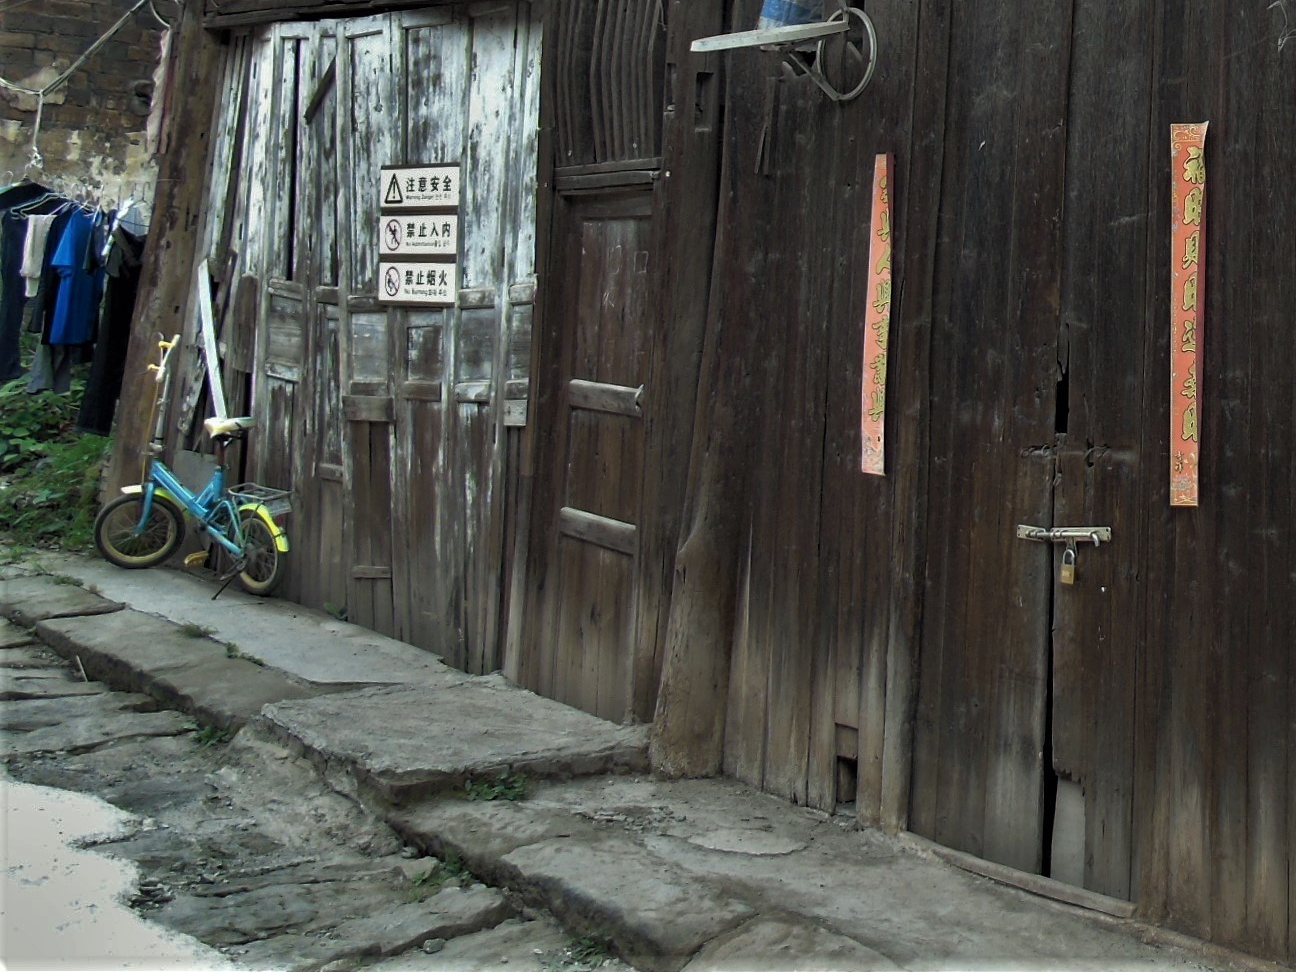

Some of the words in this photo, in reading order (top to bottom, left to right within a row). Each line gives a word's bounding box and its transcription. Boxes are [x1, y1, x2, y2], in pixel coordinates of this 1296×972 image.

[406, 175, 452, 193] 注意安全
[406, 221, 451, 238] 禁止入内
[405, 269, 447, 287] 禁止烟火
